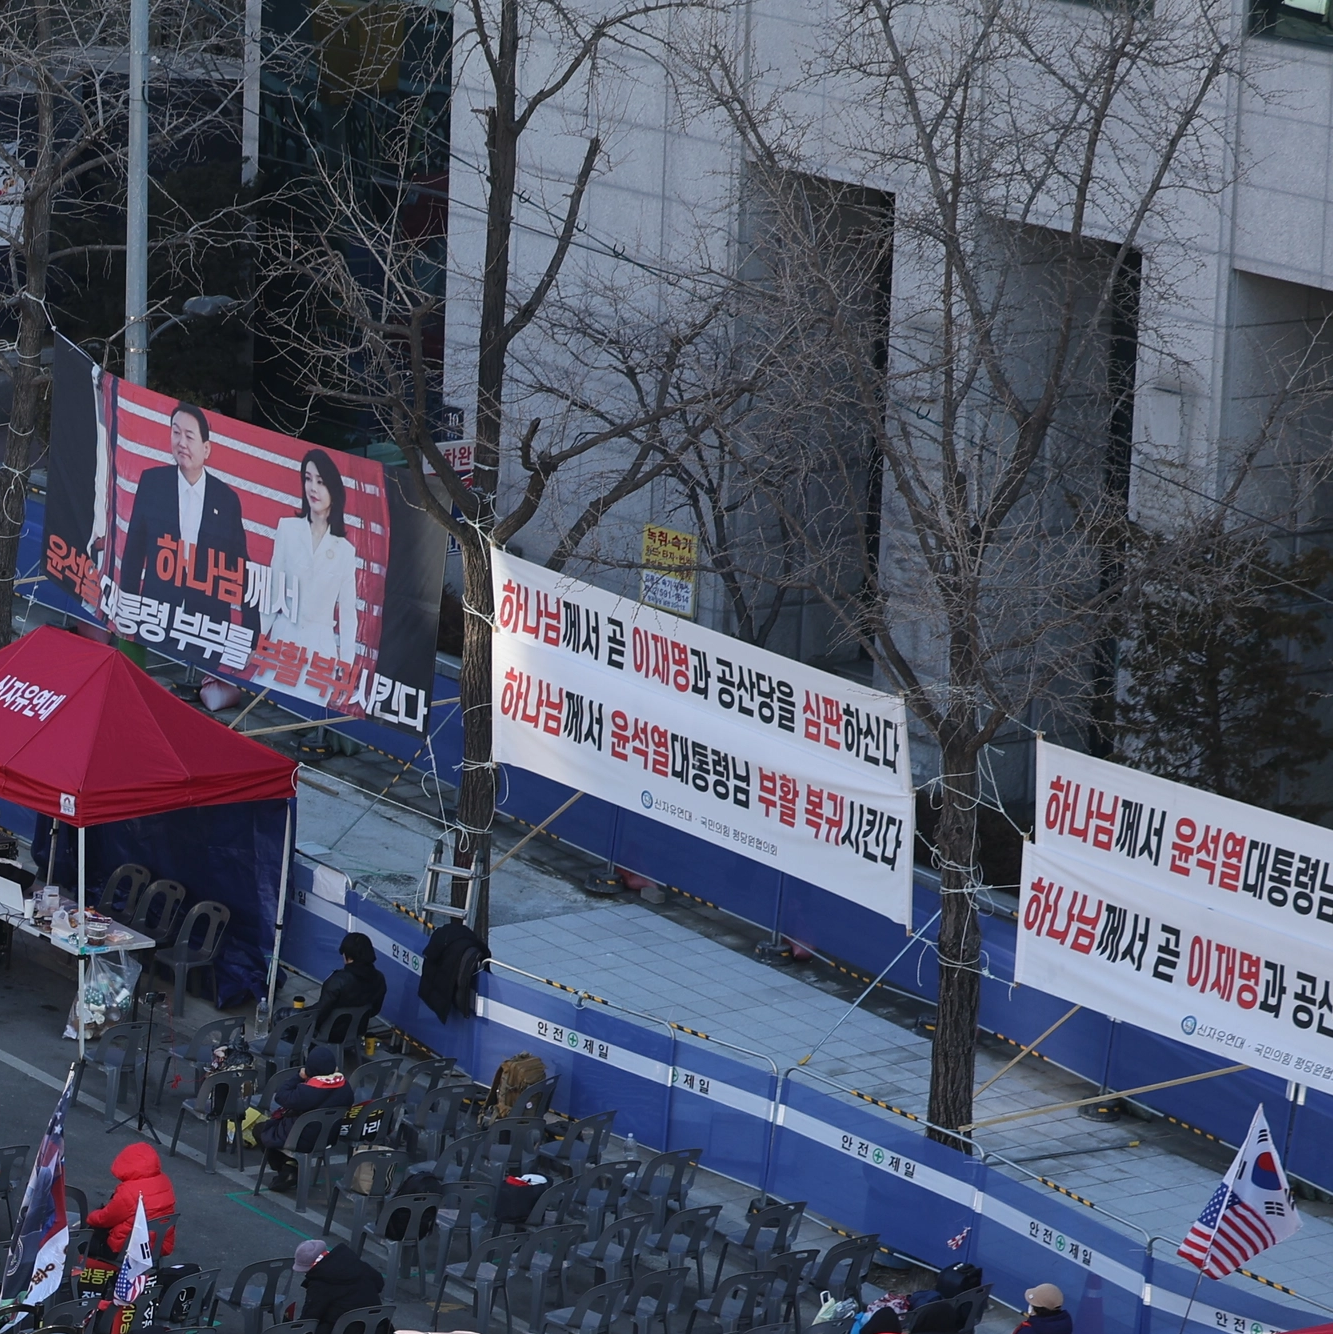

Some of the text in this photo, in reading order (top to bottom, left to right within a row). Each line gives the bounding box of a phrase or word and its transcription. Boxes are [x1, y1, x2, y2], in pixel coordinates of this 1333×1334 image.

[155, 532, 300, 624] 하나님께서
[499, 578, 901, 774] 하나님께서 곧 이재명과 공산당을 심판하신다
[500, 666, 904, 872] 하나님께서 윤석열대통령님 부활 복귀시킨다
[654, 796, 693, 823] 신자유연대
[699, 816, 731, 838] 국민의힘
[1045, 775, 1167, 866] 하나님께서
[391, 942, 411, 966] 안전
[1023, 876, 1151, 972] 하나님께서
[1152, 923, 1181, 984] 곧
[1187, 934, 1285, 1019] 이재명과
[537, 1018, 611, 1061] 안전 제일
[1197, 1022, 1245, 1050] 신자유연대
[1253, 1042, 1293, 1066] 국민의힘
[683, 1072, 711, 1096] 제일
[840, 1134, 917, 1180] 안전 제일
[1027, 1220, 1094, 1268] 안전 제일
[1215, 1310, 1247, 1334] 안전
